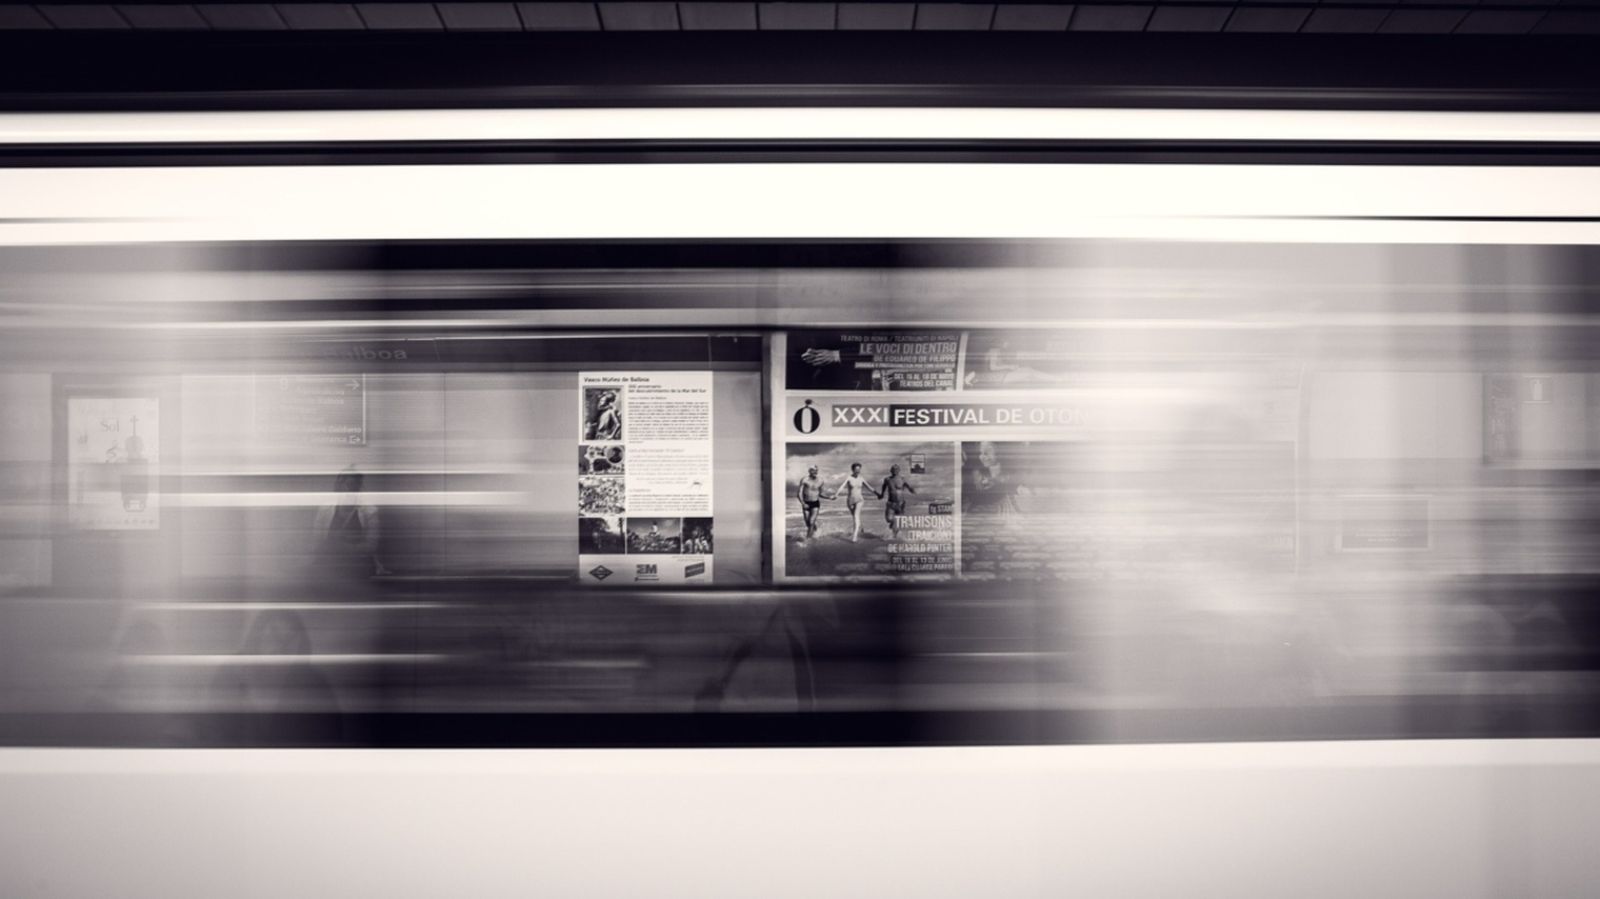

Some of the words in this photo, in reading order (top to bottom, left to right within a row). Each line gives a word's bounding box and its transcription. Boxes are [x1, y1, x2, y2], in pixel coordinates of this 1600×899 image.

[859, 343, 873, 354] LE
[876, 343, 900, 354] VOCI
[903, 343, 914, 354] DI
[915, 343, 957, 354] DENTRO
[833, 405, 887, 424] XXXI
[893, 408, 989, 425] FESTIVAL
[995, 408, 1024, 424] DE
[99, 418, 119, 433] Sol
[894, 515, 953, 529] TRAHISONS
[887, 543, 897, 553] DE
